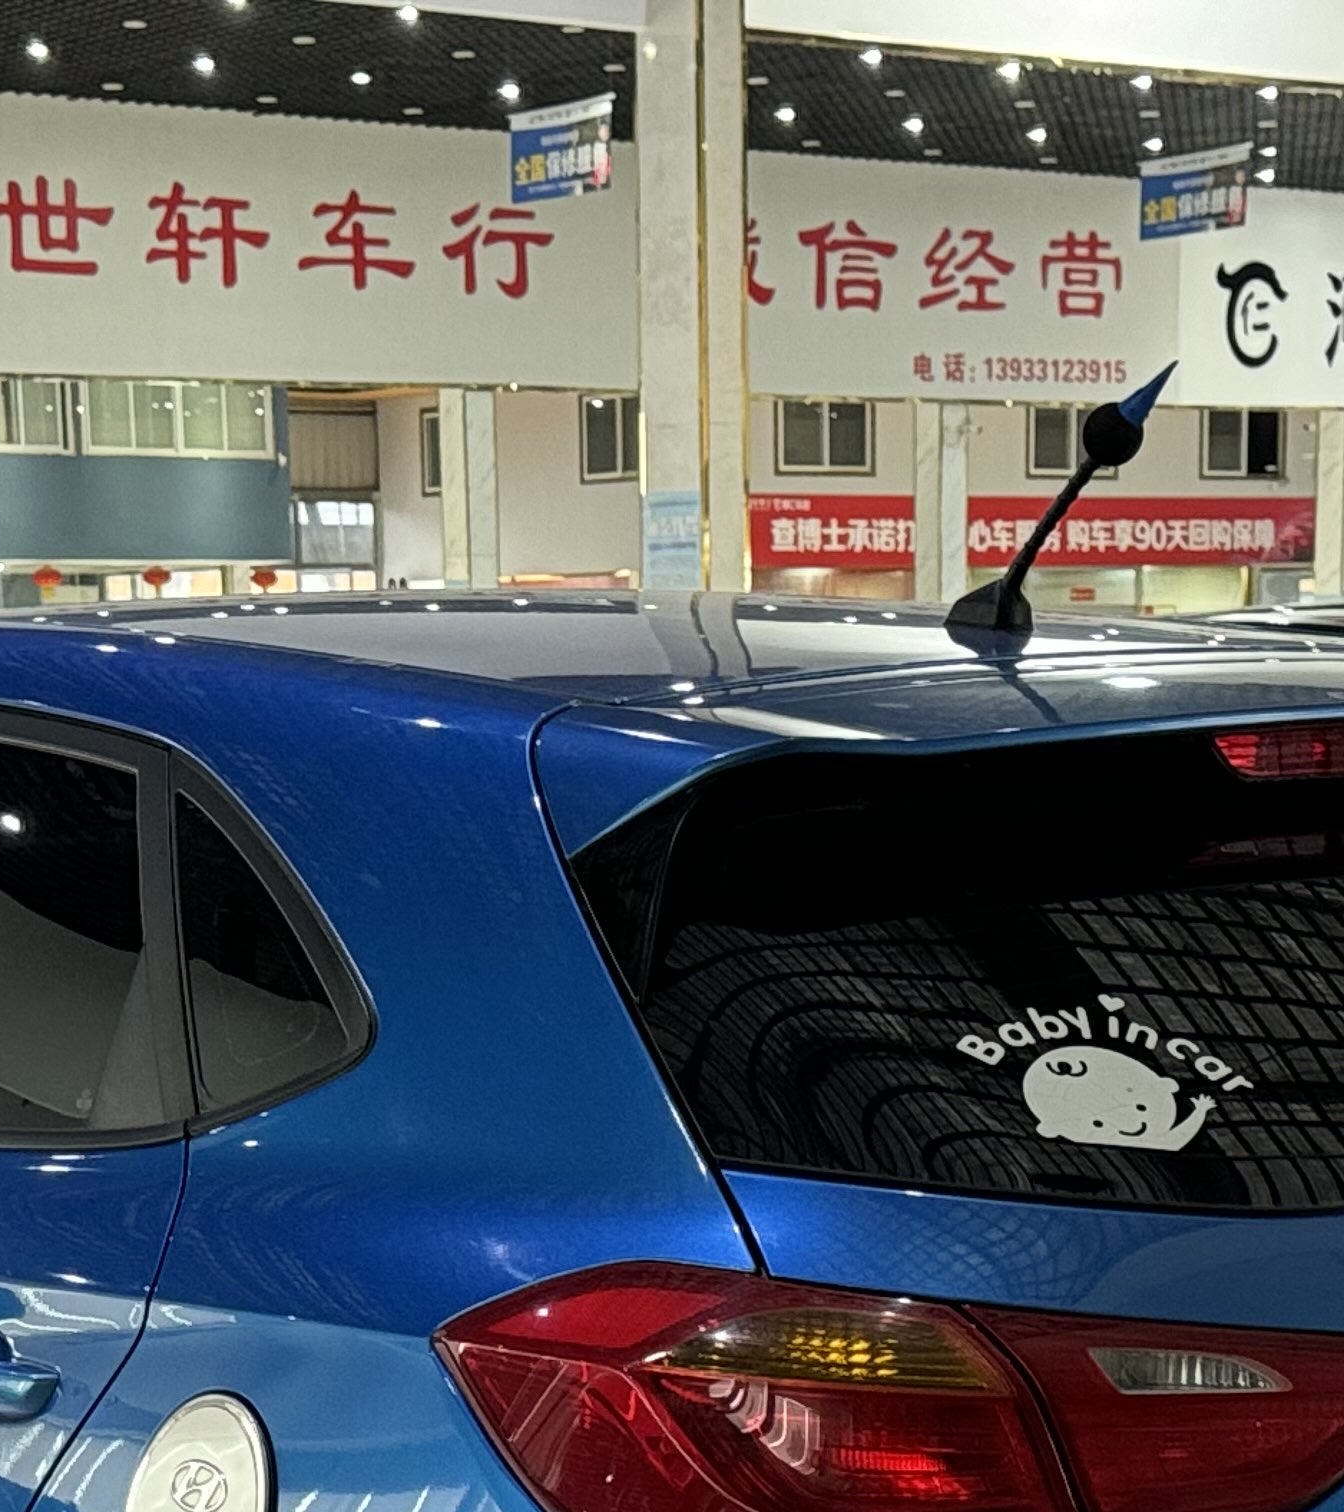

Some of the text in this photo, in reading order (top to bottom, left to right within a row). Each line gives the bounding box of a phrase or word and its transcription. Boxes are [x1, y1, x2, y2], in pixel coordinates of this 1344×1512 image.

[955, 993, 1255, 1092] Baby in car
